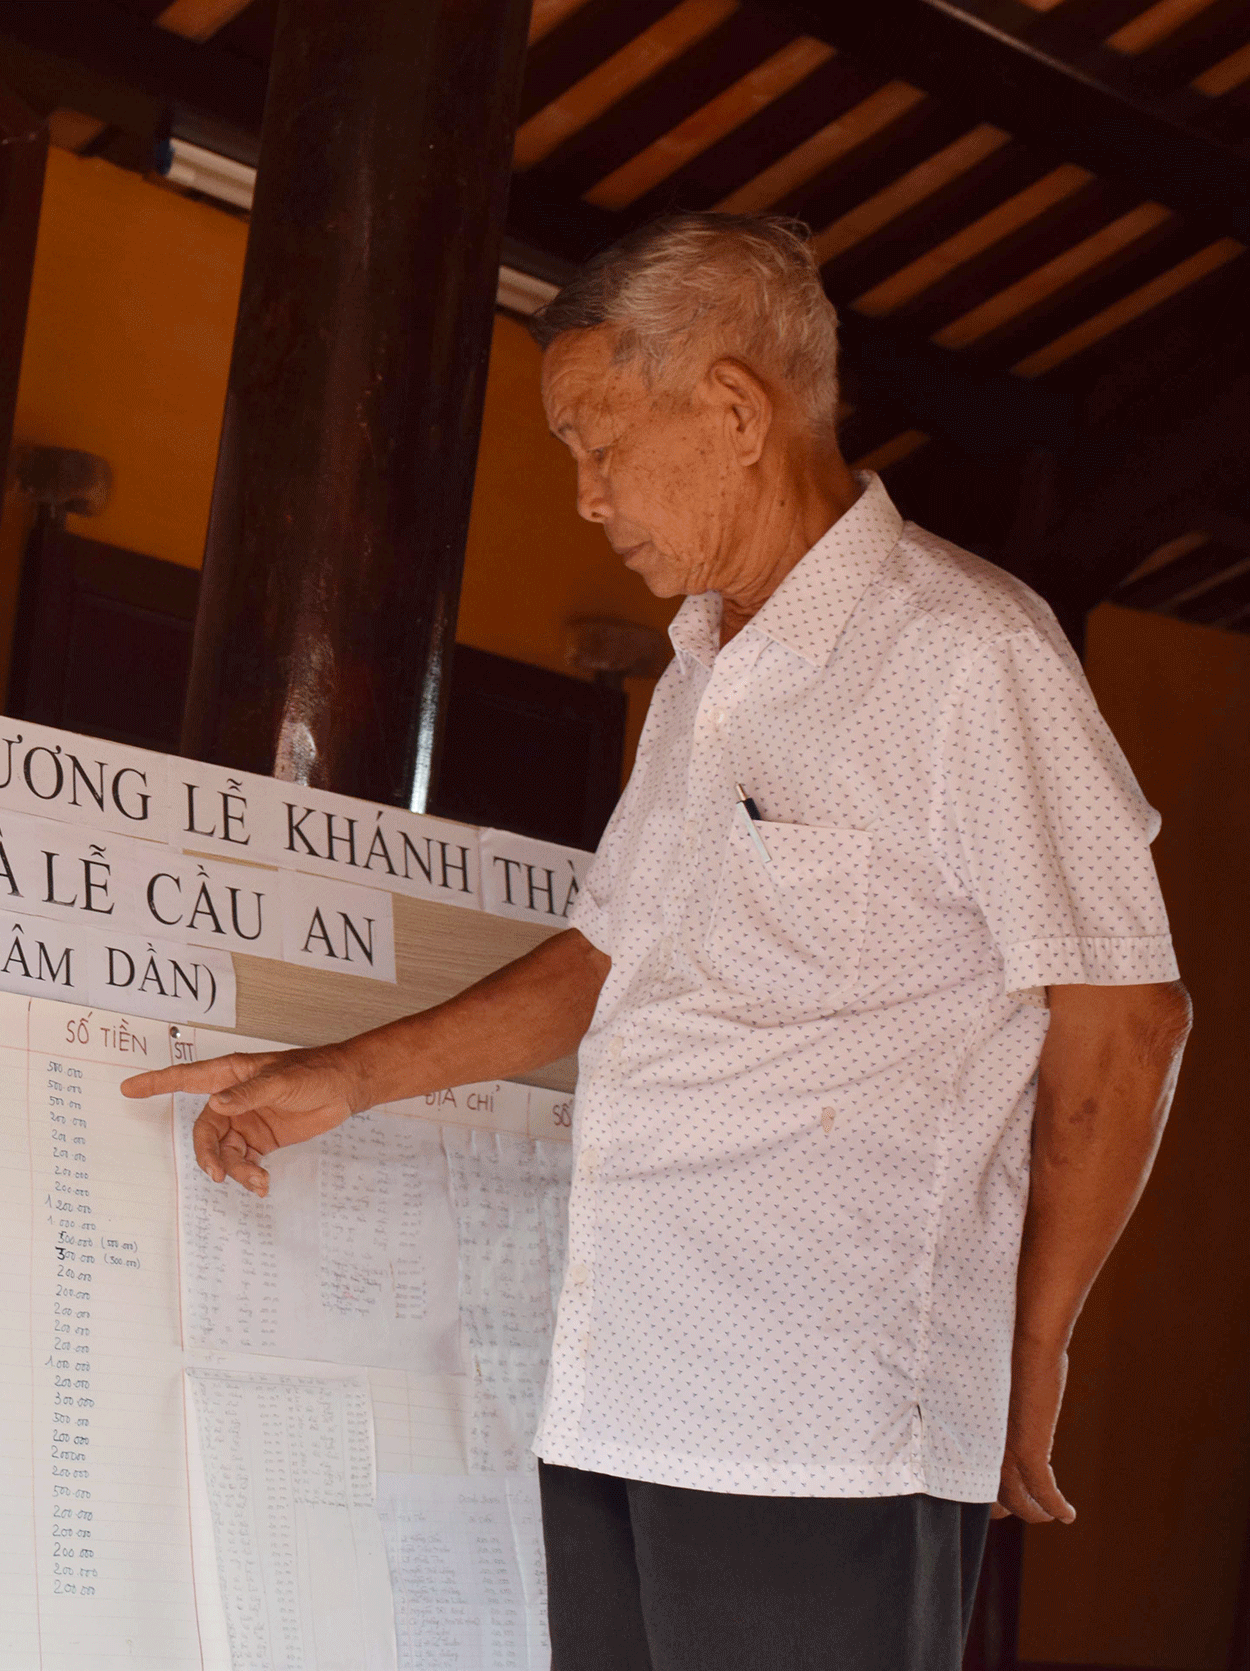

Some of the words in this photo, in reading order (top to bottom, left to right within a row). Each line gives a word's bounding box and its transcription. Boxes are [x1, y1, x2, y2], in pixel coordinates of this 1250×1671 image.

[183, 778, 250, 846] LỄ
[284, 802, 473, 894] KHÁNH
[41, 844, 115, 915] LỄ
[146, 872, 265, 941] CẦU
[302, 906, 376, 966] AN
[105, 946, 217, 1011] DẦN)
[66, 1011, 93, 1044] SỐ
[174, 1042, 194, 1061] STT
[466, 1084, 500, 1112] CHỈ
